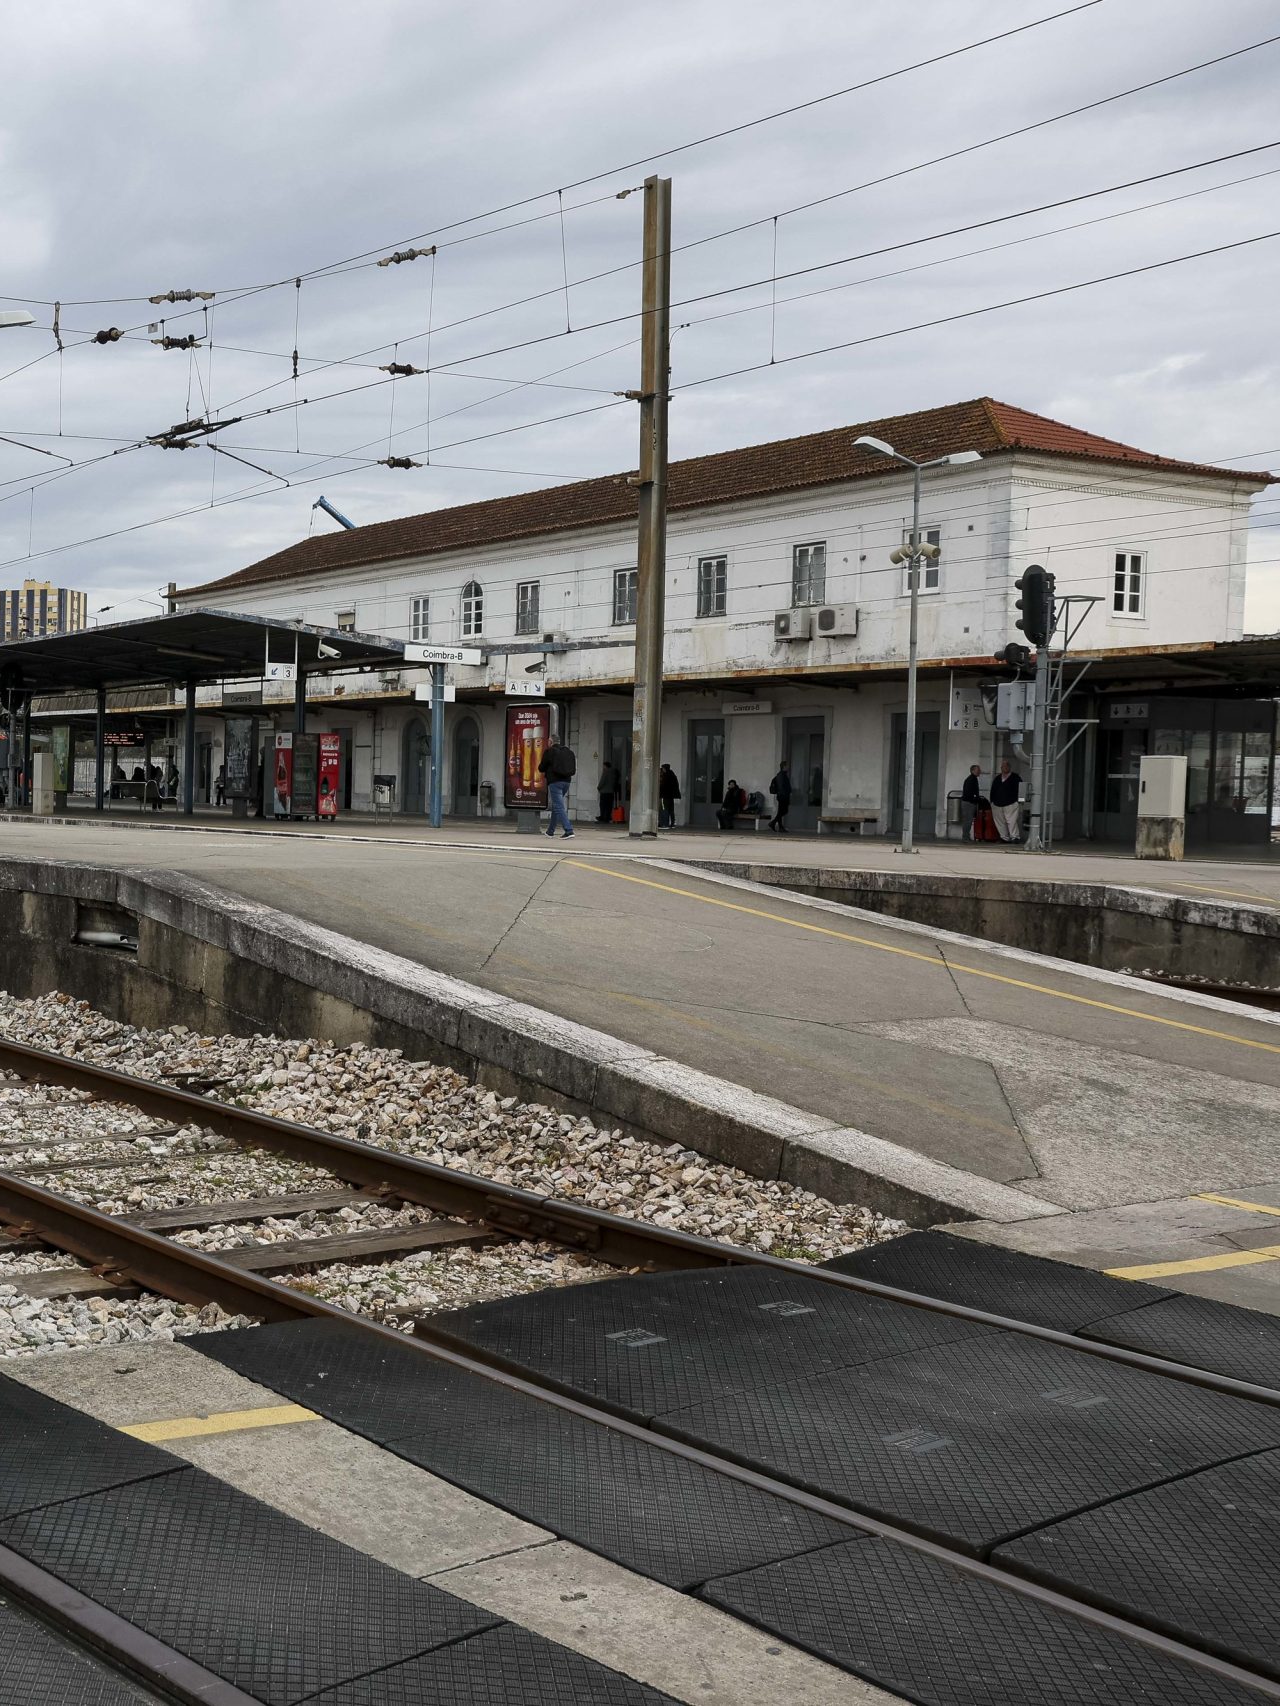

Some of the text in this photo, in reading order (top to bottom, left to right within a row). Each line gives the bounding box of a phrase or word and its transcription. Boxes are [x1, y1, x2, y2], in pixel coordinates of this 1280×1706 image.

[422, 649, 463, 660] Coimbra-B
[285, 670, 291, 678] 3
[511, 683, 517, 691] A
